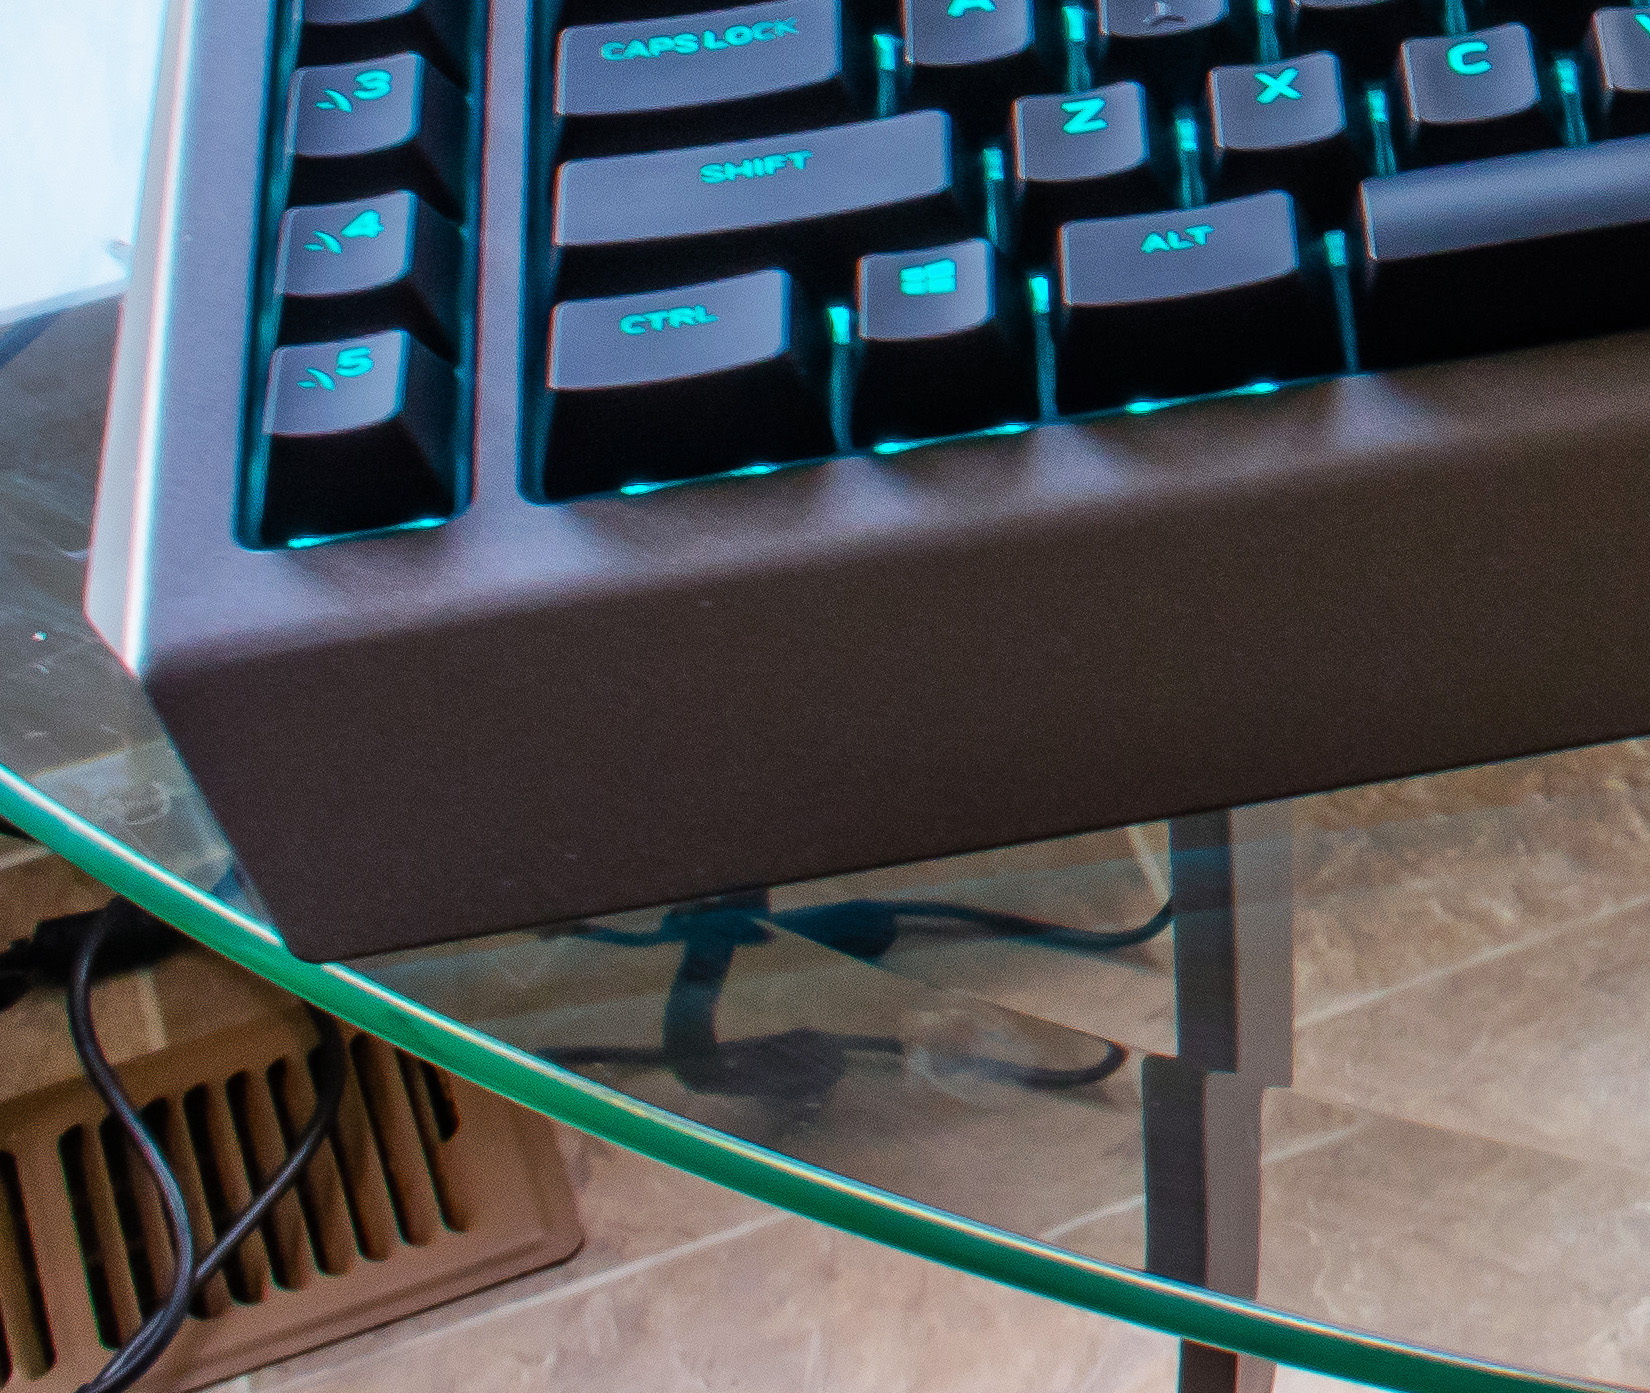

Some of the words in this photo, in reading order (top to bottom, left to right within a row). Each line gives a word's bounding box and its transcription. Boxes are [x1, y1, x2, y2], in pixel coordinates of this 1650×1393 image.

[600, 34, 701, 61] CAPS
[703, 17, 797, 52] LOCK
[1447, 40, 1492, 75] C
[352, 69, 393, 101] 3
[1254, 67, 1302, 104] X
[1061, 97, 1108, 134] Z
[699, 150, 813, 184] SHIFT
[341, 209, 385, 239] 4
[1141, 224, 1214, 254] ALT
[619, 304, 719, 336] CTRL
[335, 346, 374, 378] 5
